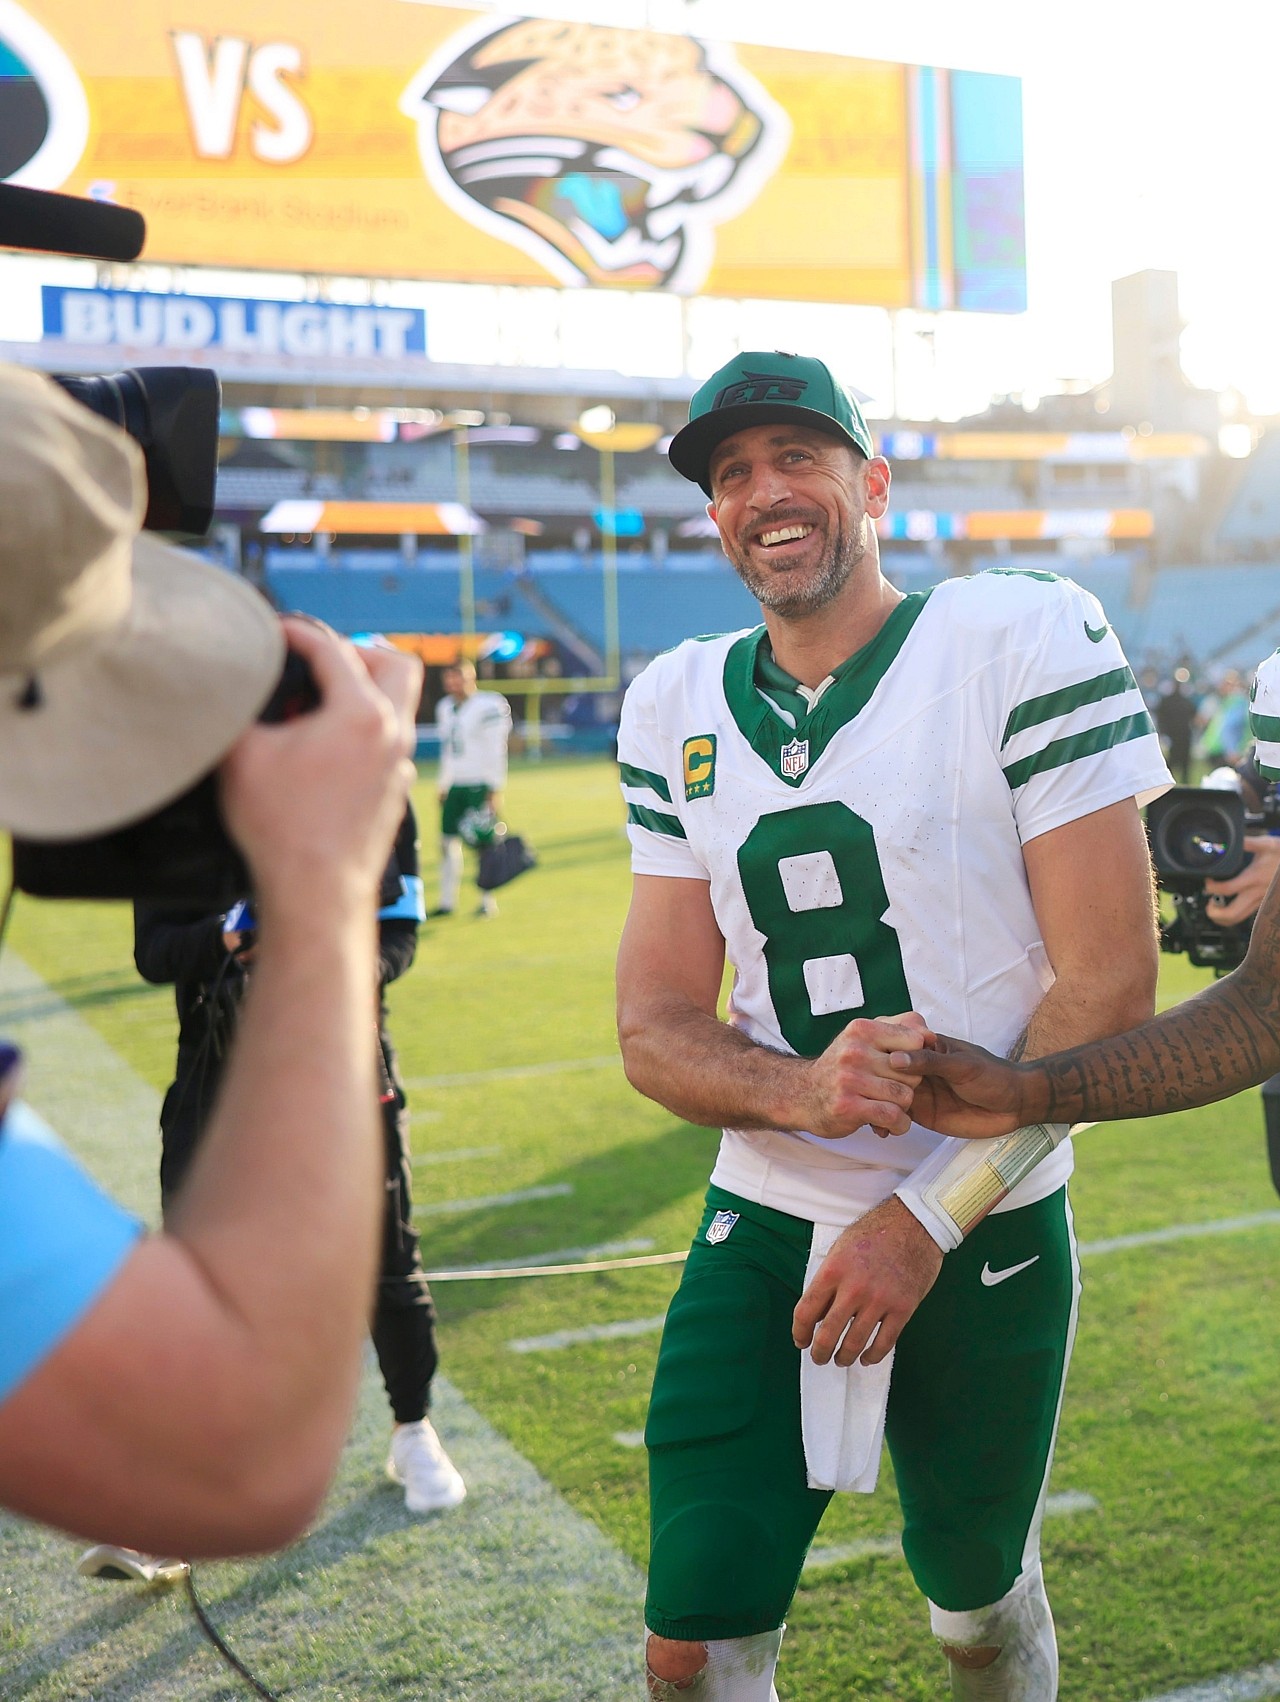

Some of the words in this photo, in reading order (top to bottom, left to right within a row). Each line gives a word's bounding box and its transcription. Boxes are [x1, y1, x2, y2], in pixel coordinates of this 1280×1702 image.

[171, 31, 315, 162] VS
[63, 290, 216, 347] BUD
[220, 299, 416, 358] LIGHT
[684, 738, 713, 785] C
[785, 756, 804, 773] NFL
[736, 800, 914, 1057] 8
